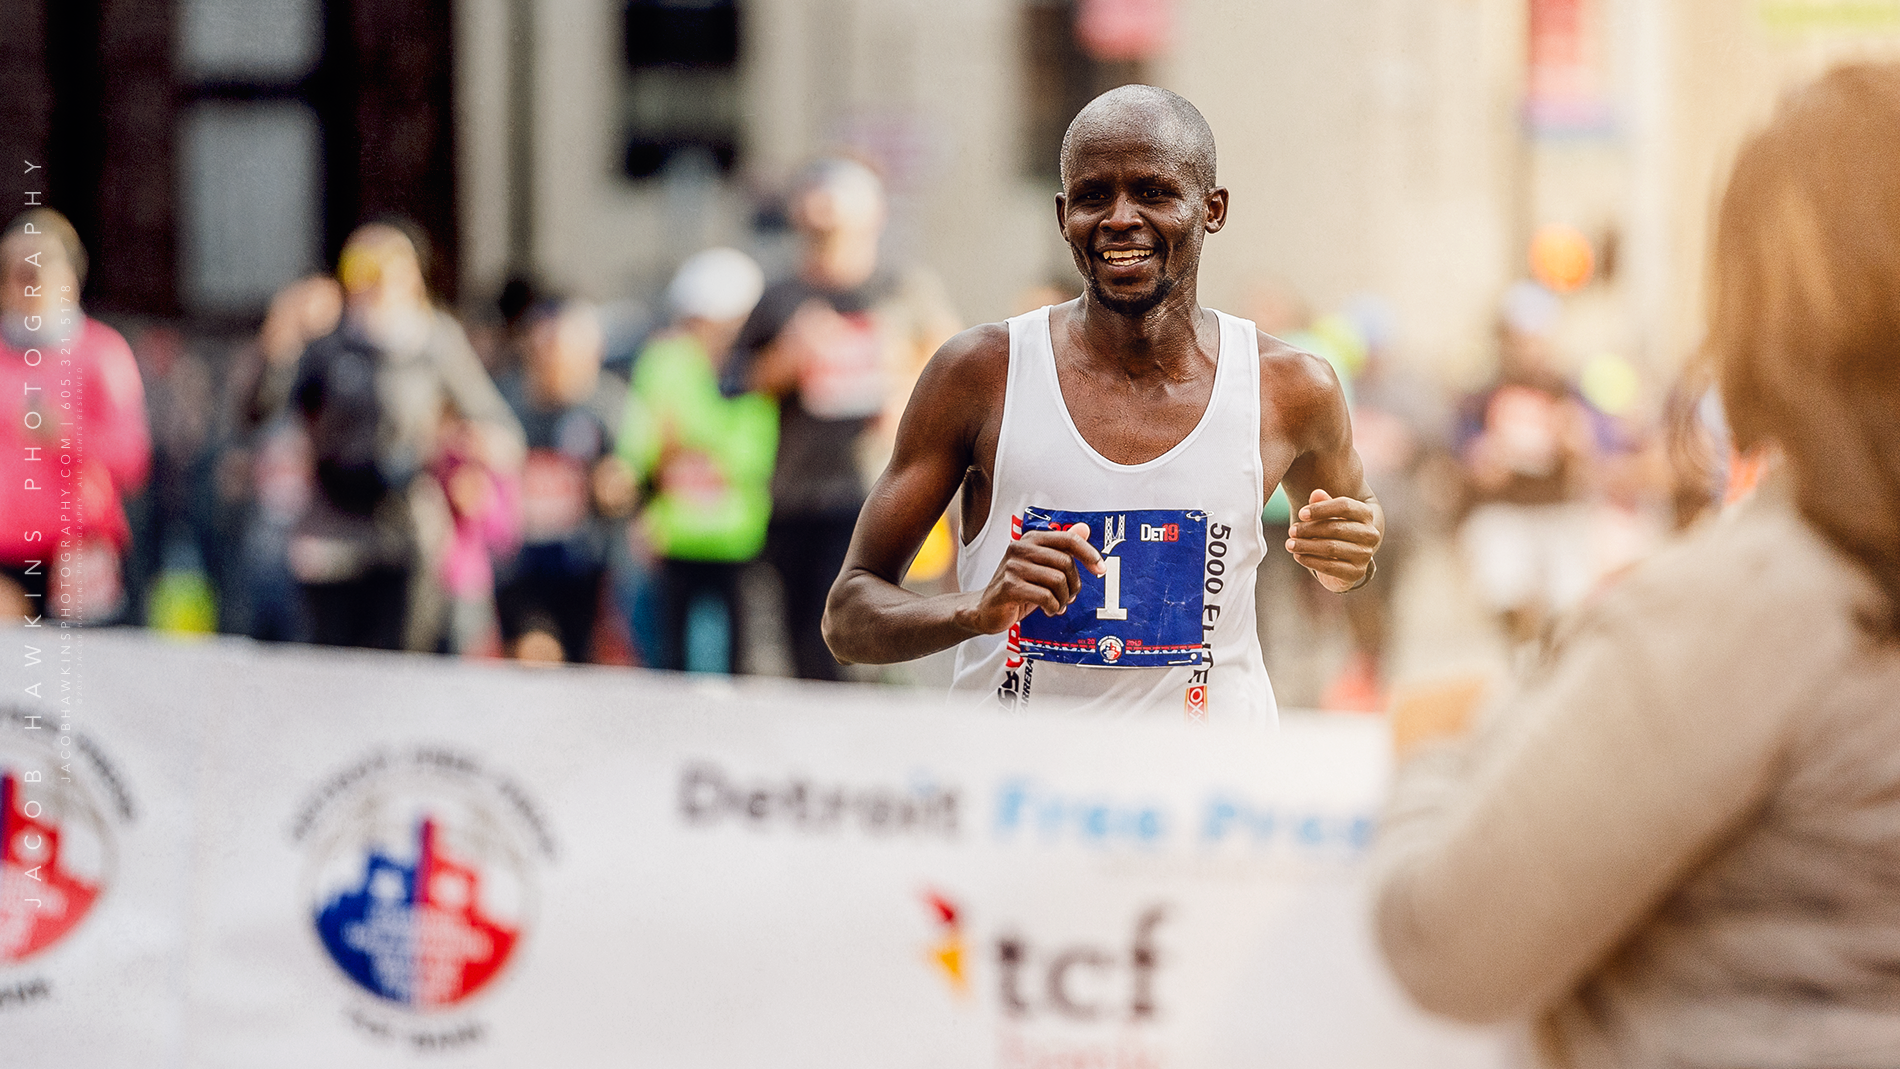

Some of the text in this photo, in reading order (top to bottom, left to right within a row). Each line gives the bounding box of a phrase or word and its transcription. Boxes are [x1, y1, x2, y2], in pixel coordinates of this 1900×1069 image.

[1096, 555, 1128, 620] 1
[1205, 522, 1231, 595] 5000
[1020, 658, 1035, 714] ARRERA
[1187, 687, 1206, 732] OXX
[679, 761, 961, 838] Detroit
[1200, 784, 1372, 856] Pres
[994, 905, 1172, 1022] tcf
